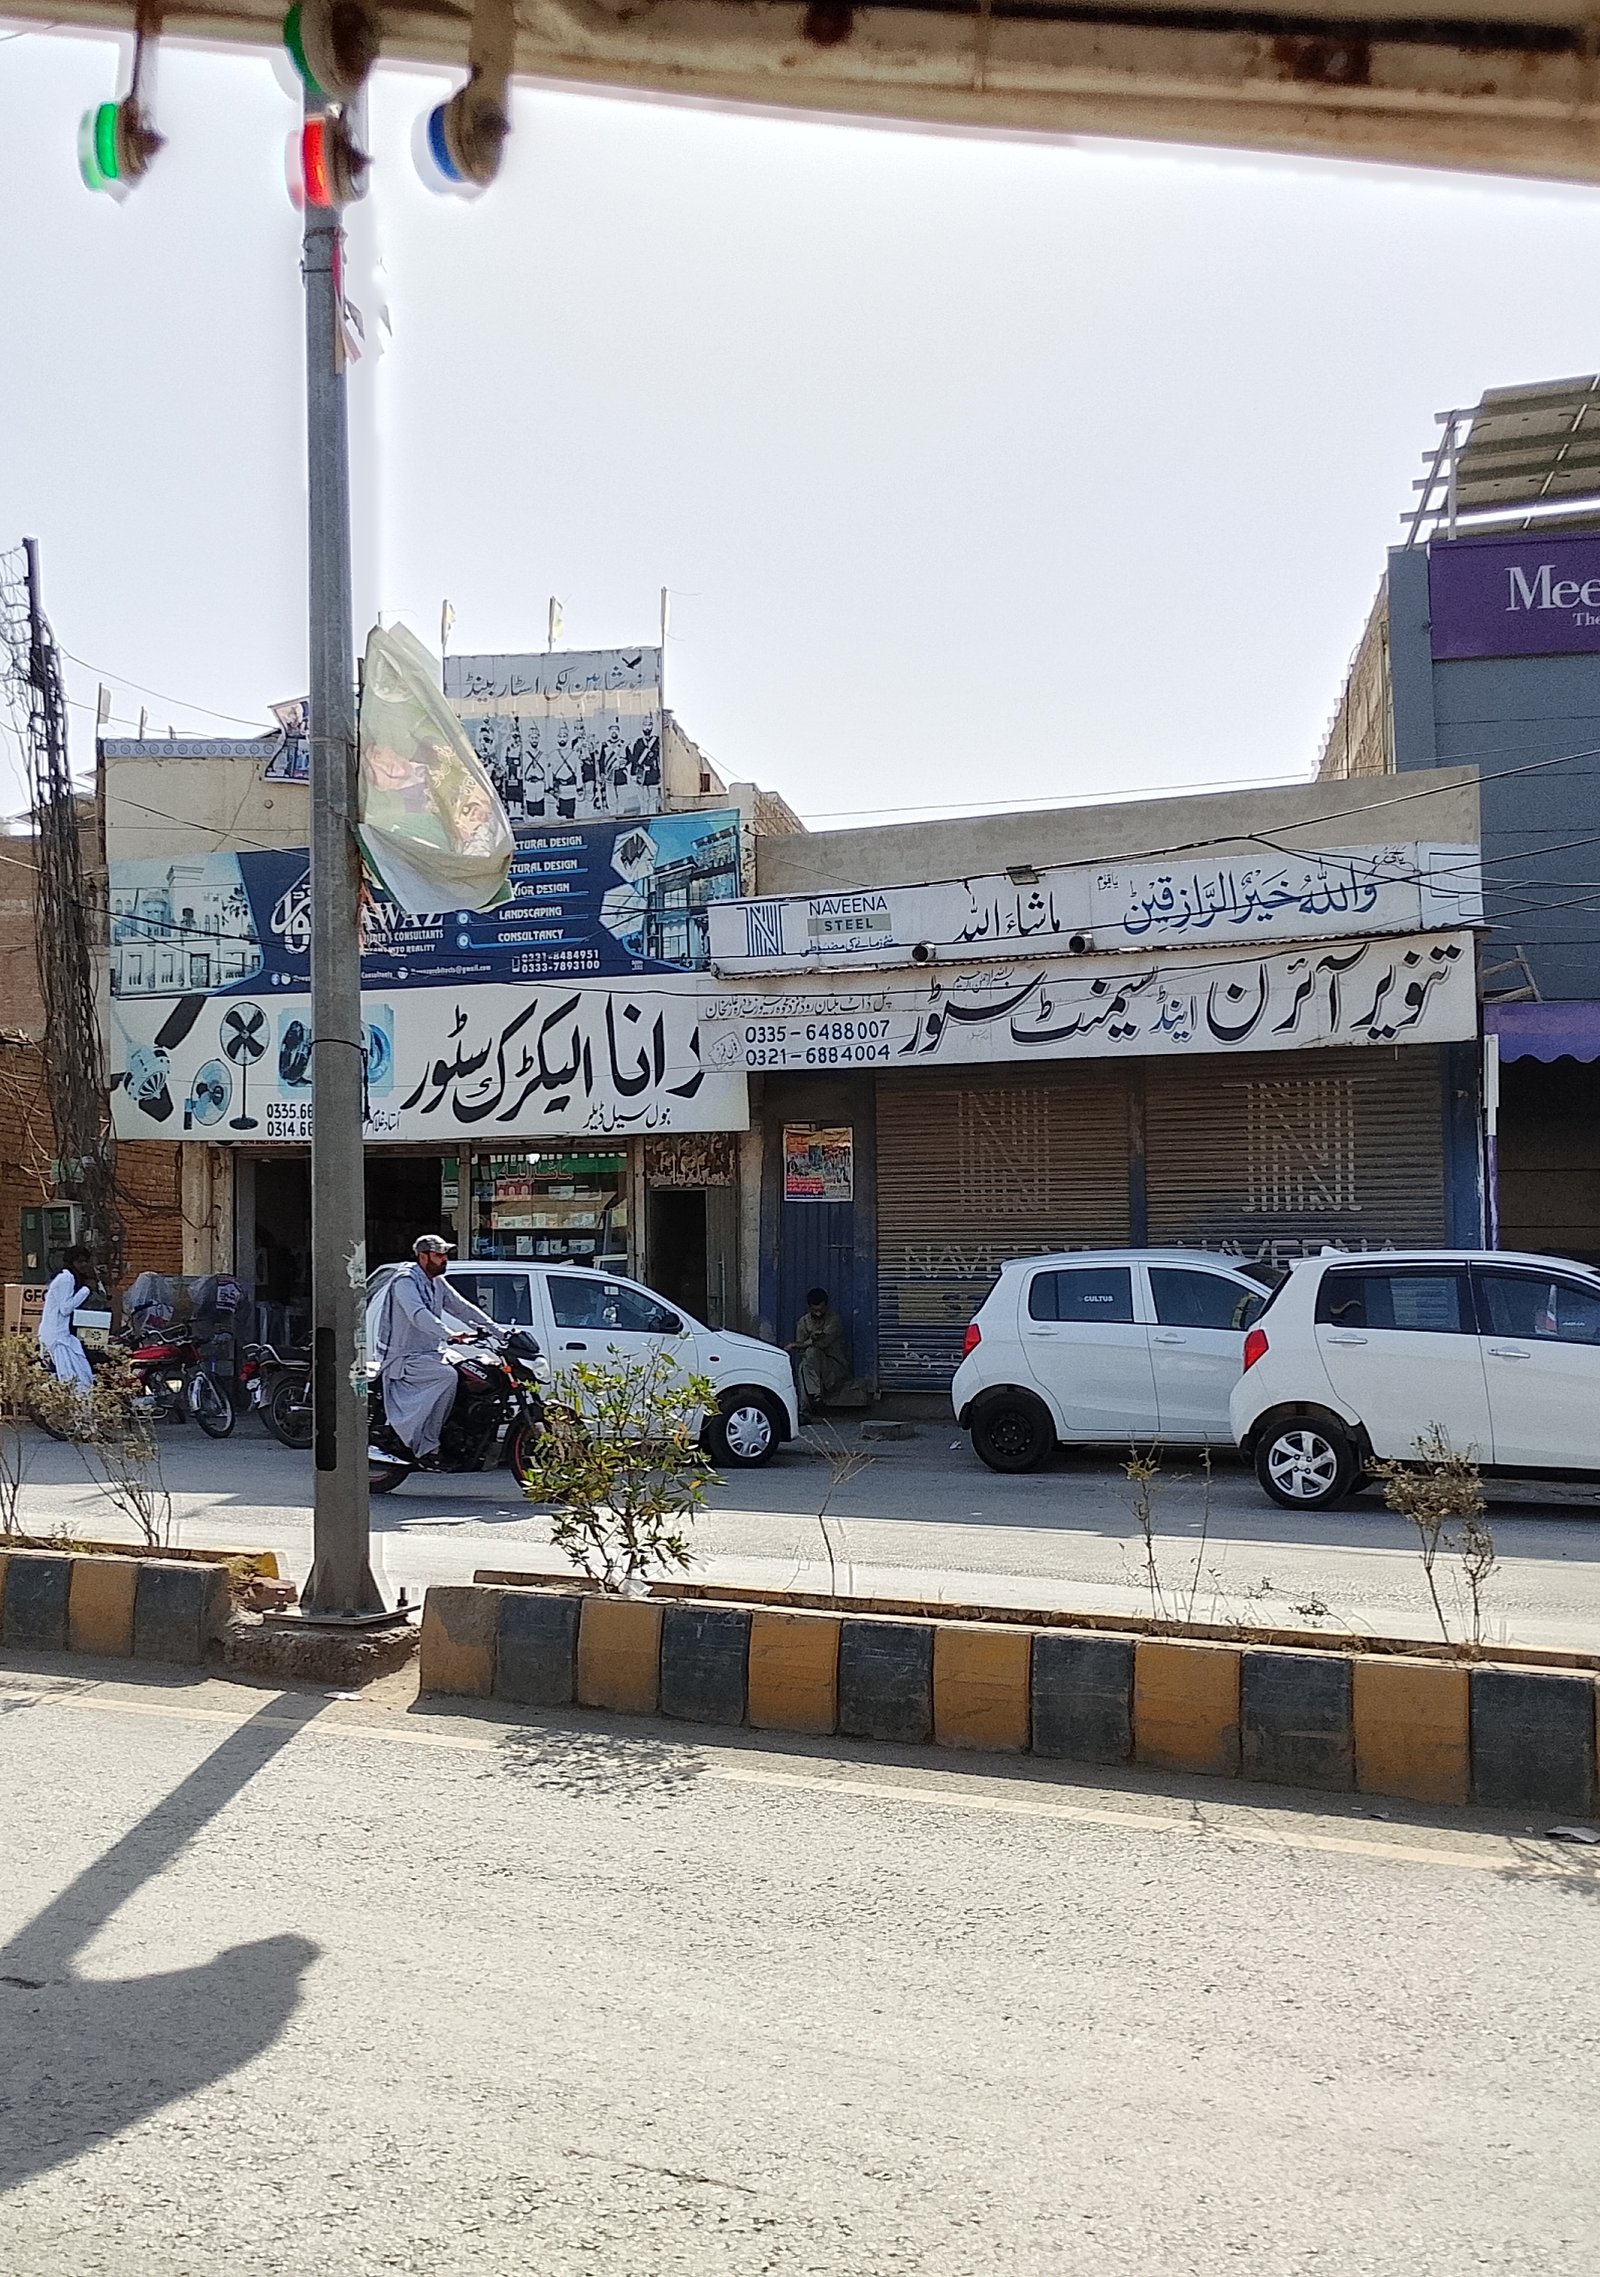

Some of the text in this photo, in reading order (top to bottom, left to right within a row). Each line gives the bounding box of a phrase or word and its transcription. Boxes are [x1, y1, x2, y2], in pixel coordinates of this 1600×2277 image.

[549, 835, 582, 848] DESIGN
[544, 859, 577, 871] DESIGN
[535, 882, 570, 895] DESIGN
[808, 895, 888, 916] NAVEENA
[498, 906, 562, 920] LANDSCAPING
[824, 917, 874, 932] STEEL
[394, 929, 444, 942] CONSULTANTS
[497, 929, 564, 942] CONSULTANCY
[406, 944, 436, 953] REALITY
[521, 960, 600, 973] 0333-7893100
[1350, 942, 1463, 1041] تنویر
[1010, 966, 1159, 1046] سیمنٹ
[1149, 985, 1197, 1042] اینڈ
[745, 1019, 890, 1044] 0335-6488007
[745, 1043, 890, 1066] 0321-6884004
[602, 1102, 652, 1133] سیل
